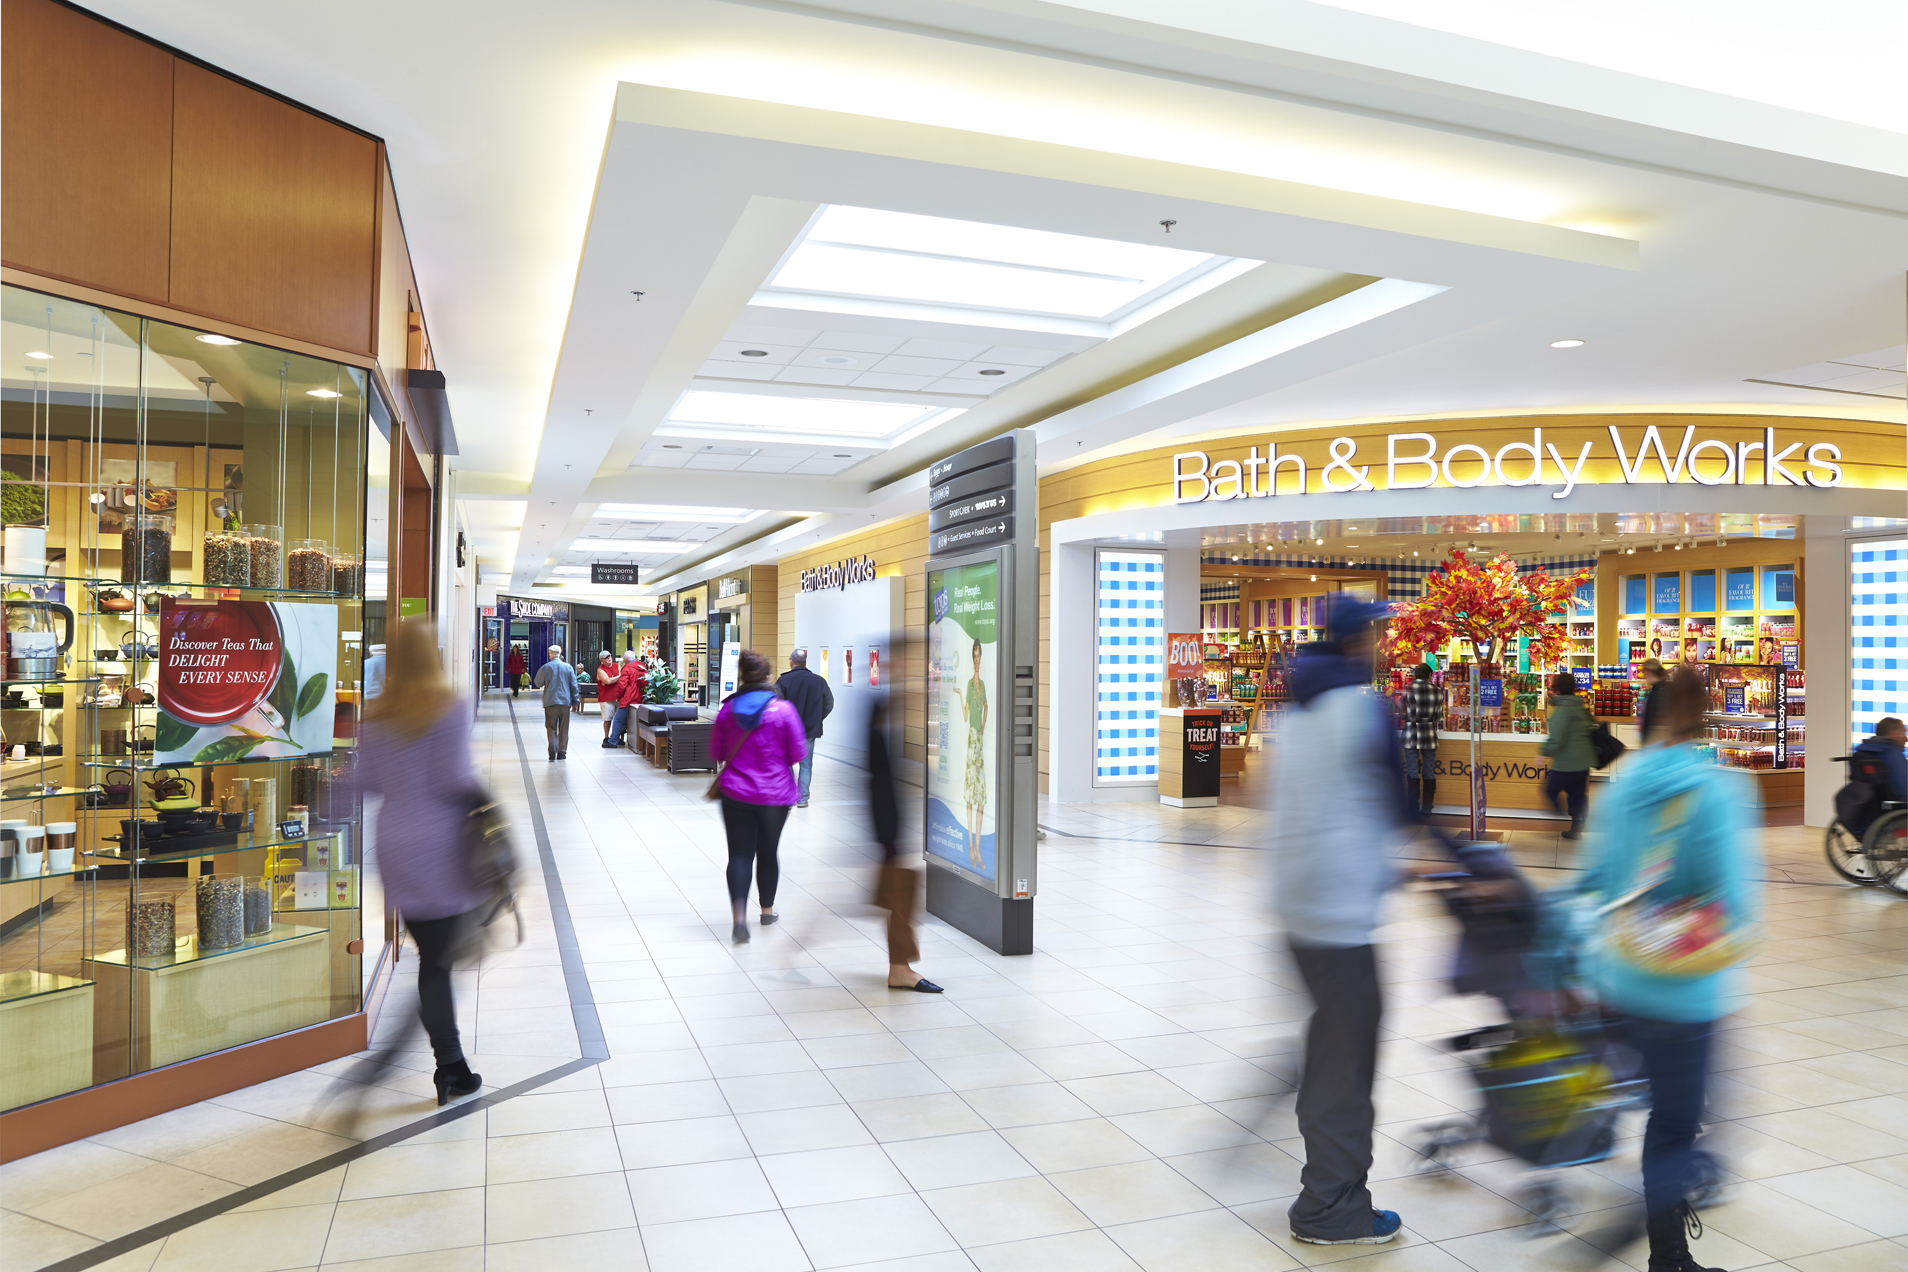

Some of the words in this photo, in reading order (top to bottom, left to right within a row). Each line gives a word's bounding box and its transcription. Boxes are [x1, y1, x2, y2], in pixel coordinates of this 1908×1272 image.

[1173, 442, 1306, 504] Bath
[1321, 437, 1375, 492] &
[1388, 427, 1593, 499] Body
[1607, 425, 1843, 488] Works
[974, 528, 985, 537] Food
[985, 525, 997, 535] Court
[801, 568, 817, 593] Bath
[817, 566, 825, 590] &
[824, 561, 846, 592] Body
[845, 554, 875, 584] Works
[954, 587, 963, 598] Real
[964, 584, 981, 598] People.
[934, 589, 948, 615] tops
[954, 603, 963, 613] Real
[964, 601, 980, 614] Weight
[483, 607, 495, 615] EXIT
[532, 602, 553, 616] COMPANY
[169, 637, 218, 650] Discover
[221, 638, 245, 650] Teas
[249, 638, 273, 650] That
[1170, 640, 1202, 666] BOO!
[169, 654, 229, 667] DELIGHT
[179, 671, 224, 684] EVERY
[226, 671, 267, 683] SENSE
[1208, 671, 1228, 682] FALL!
[1192, 719, 1206, 728] TRICK
[1206, 720, 1214, 728] OR
[1778, 704, 1786, 730] Body
[1186, 728, 1218, 743] TREAT
[1504, 762, 1552, 779] Work
[274, 874, 295, 884] CAUT
